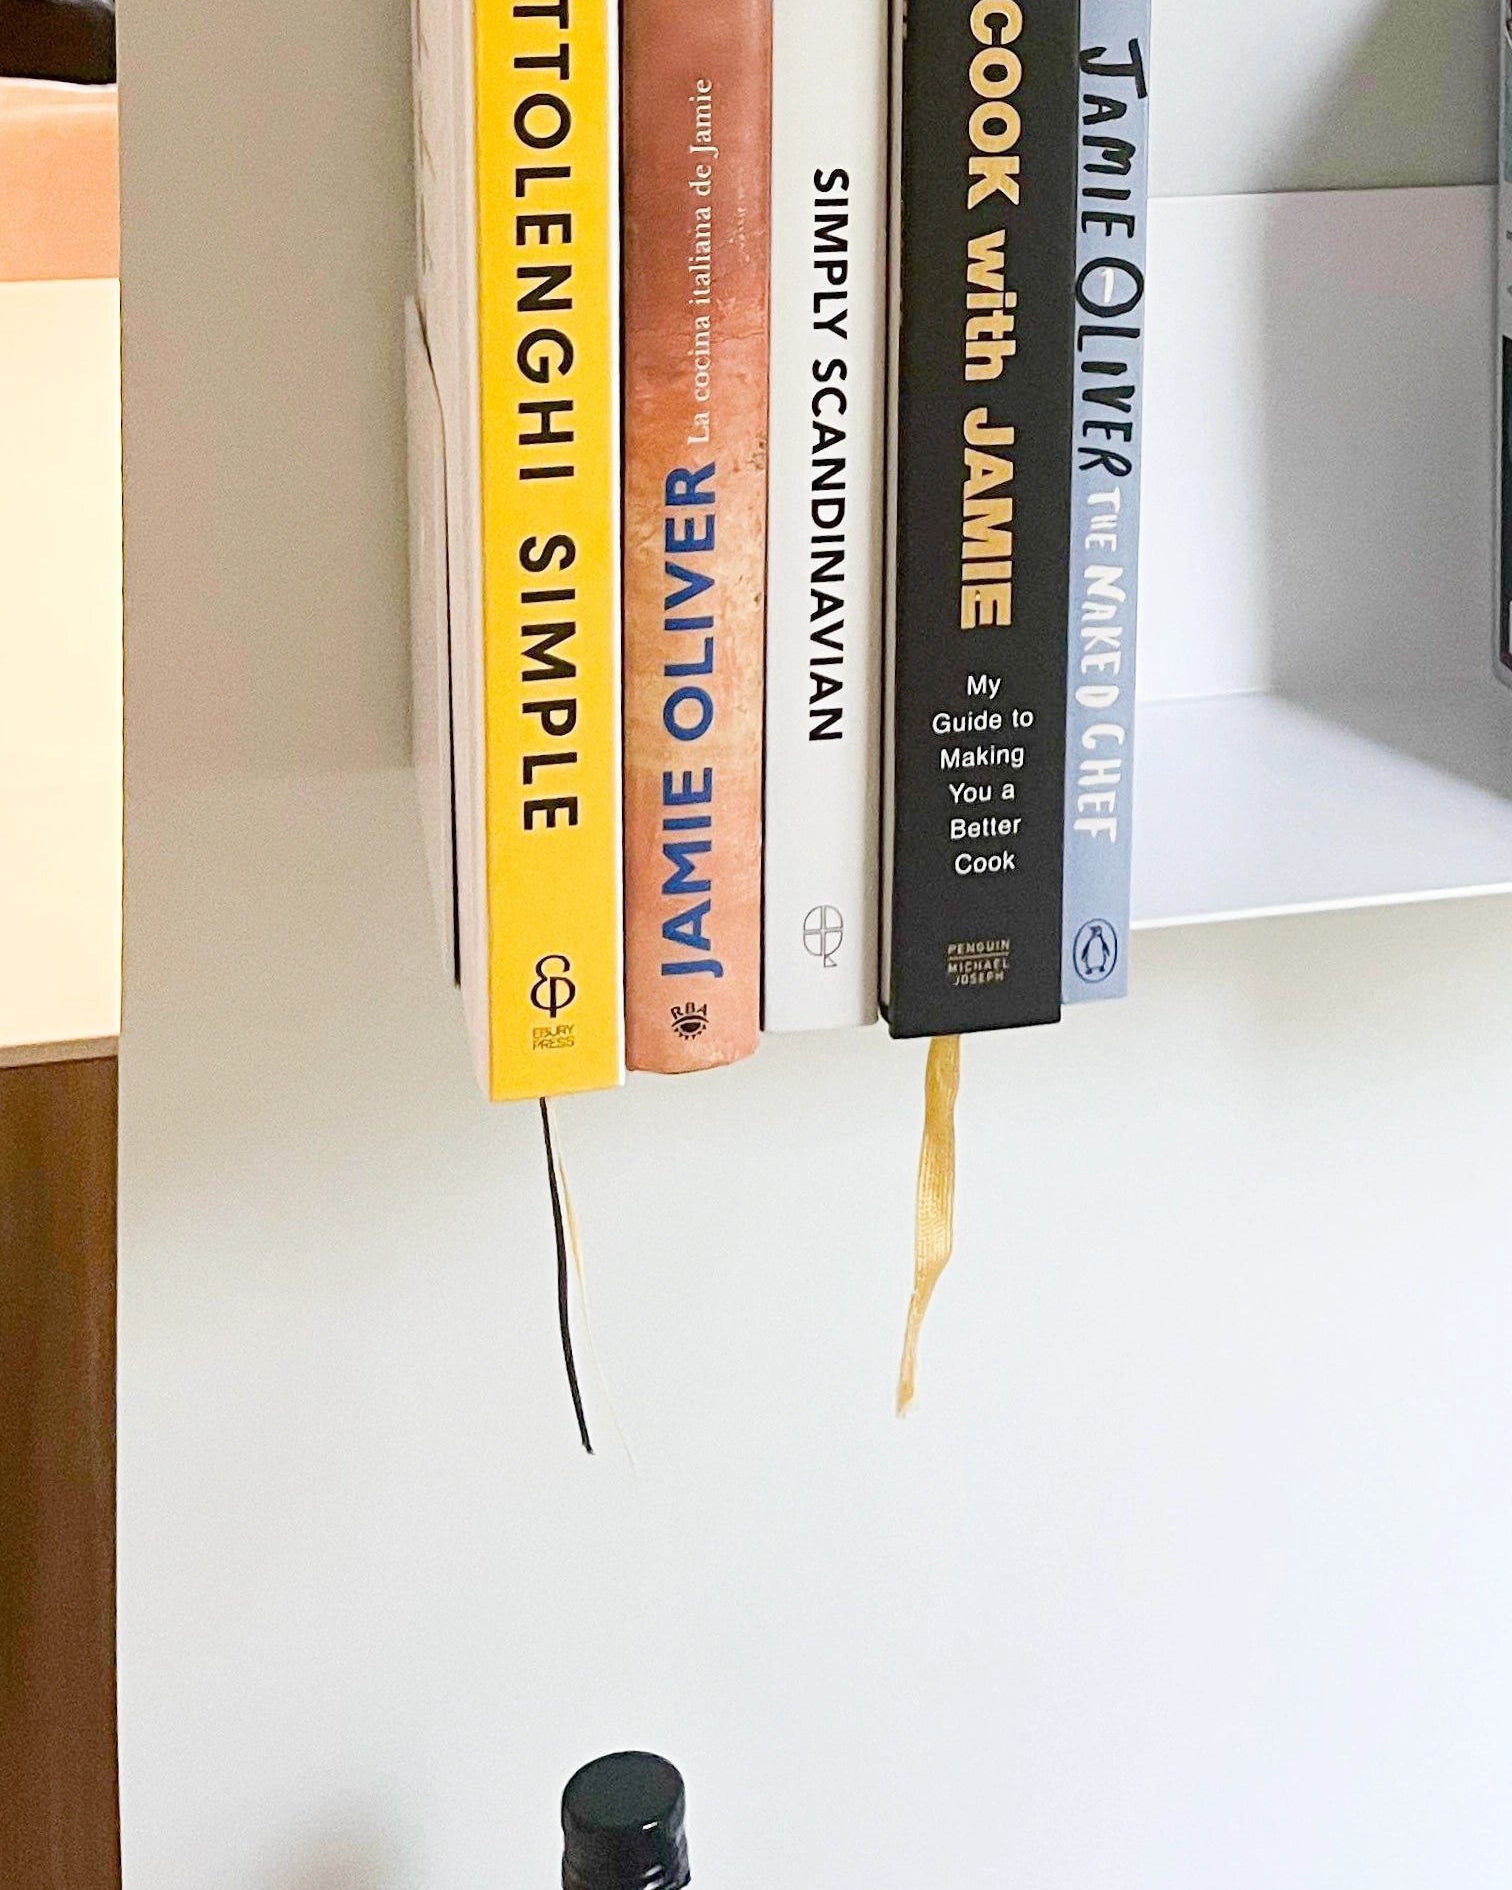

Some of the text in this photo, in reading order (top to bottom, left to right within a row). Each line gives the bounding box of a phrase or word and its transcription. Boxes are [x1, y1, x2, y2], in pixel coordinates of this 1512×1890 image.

[688, 79, 719, 445] La cocina italiana de Jamie
[965, 229, 1020, 381] with
[1073, 38, 1148, 843] JAMIE OLIVER THE NAKED CHEF
[807, 169, 850, 742] SIMPLY SCANDINAVIAN
[961, 407, 1014, 629] JAMIE
[518, 534, 579, 831] SIMPLE
[967, 675, 1000, 699] My
[661, 460, 724, 979] JAMIE OLIVER
[932, 708, 1034, 735] Guide to
[940, 745, 1025, 771] Making
[949, 781, 1015, 805] You a
[950, 816, 1021, 840] Better
[954, 850, 1015, 875] Cook
[948, 939, 1011, 955] PENGUIN
[948, 958, 1010, 973] MICHAEL
[954, 972, 1005, 987] JOSEPH
